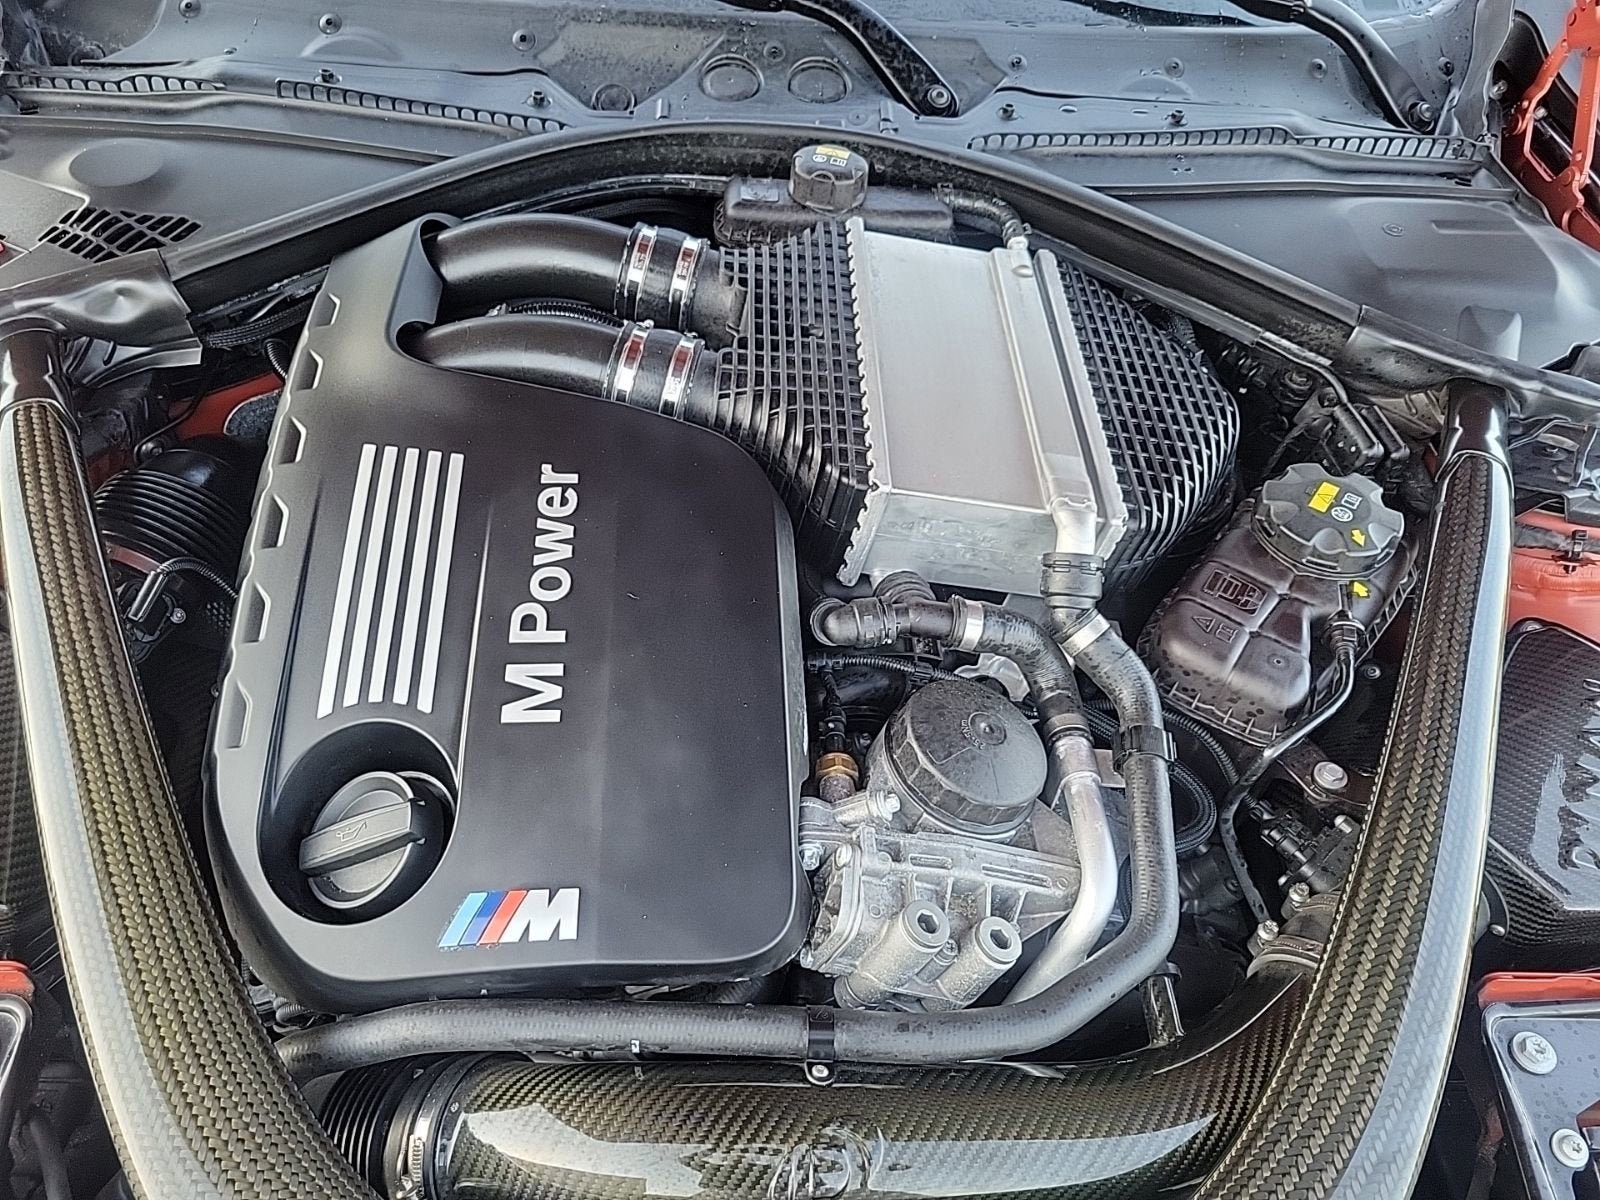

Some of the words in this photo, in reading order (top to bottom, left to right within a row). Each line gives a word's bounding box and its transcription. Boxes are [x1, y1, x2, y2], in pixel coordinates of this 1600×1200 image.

[508, 463, 579, 644] Power
[500, 662, 565, 724] M
[497, 887, 580, 943] M
